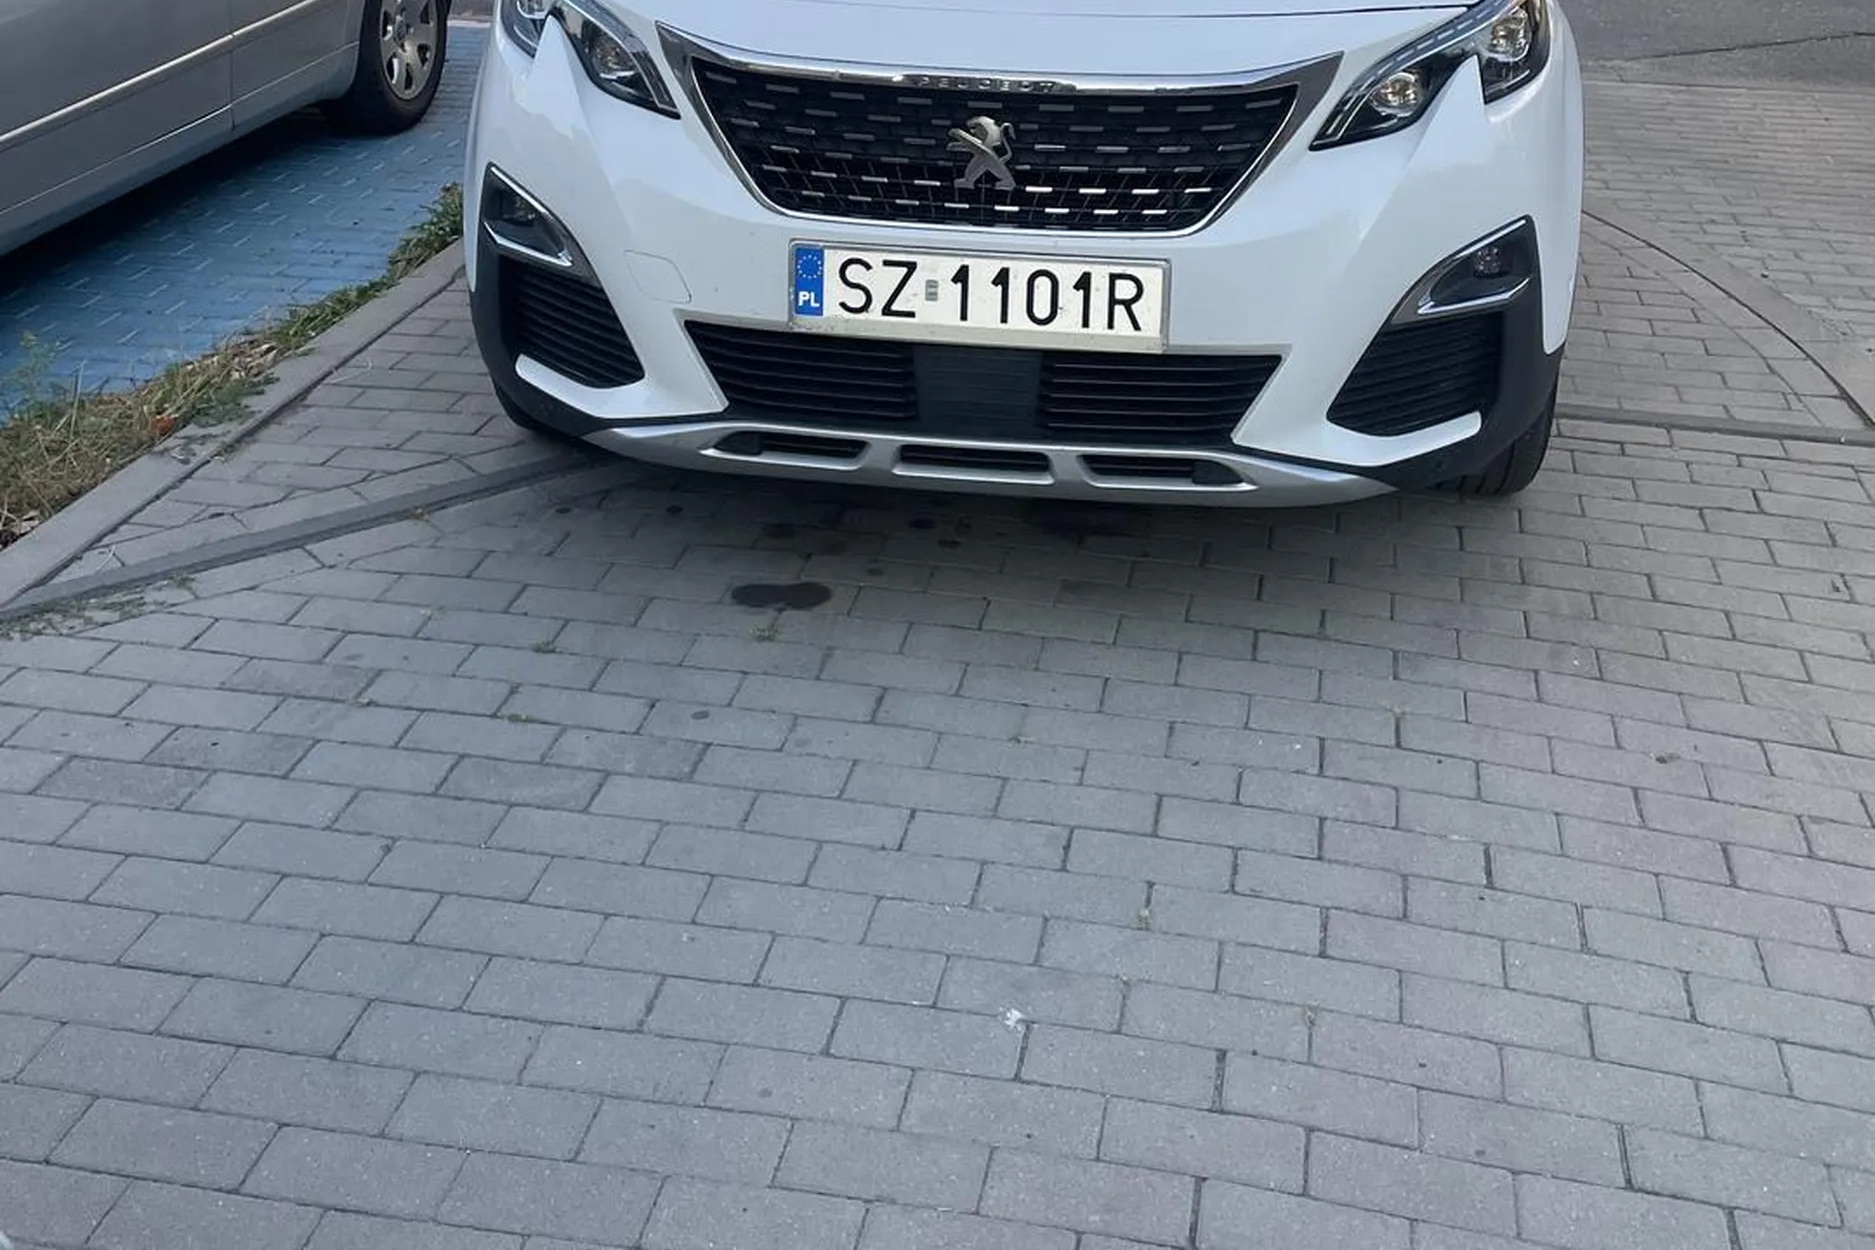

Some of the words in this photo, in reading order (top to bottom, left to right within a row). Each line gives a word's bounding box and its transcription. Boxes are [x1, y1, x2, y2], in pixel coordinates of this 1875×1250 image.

[916, 75, 1054, 93] PEUGEOT
[798, 291, 821, 308] PL
[837, 257, 918, 318] SZ
[949, 263, 1145, 332] 1101R
